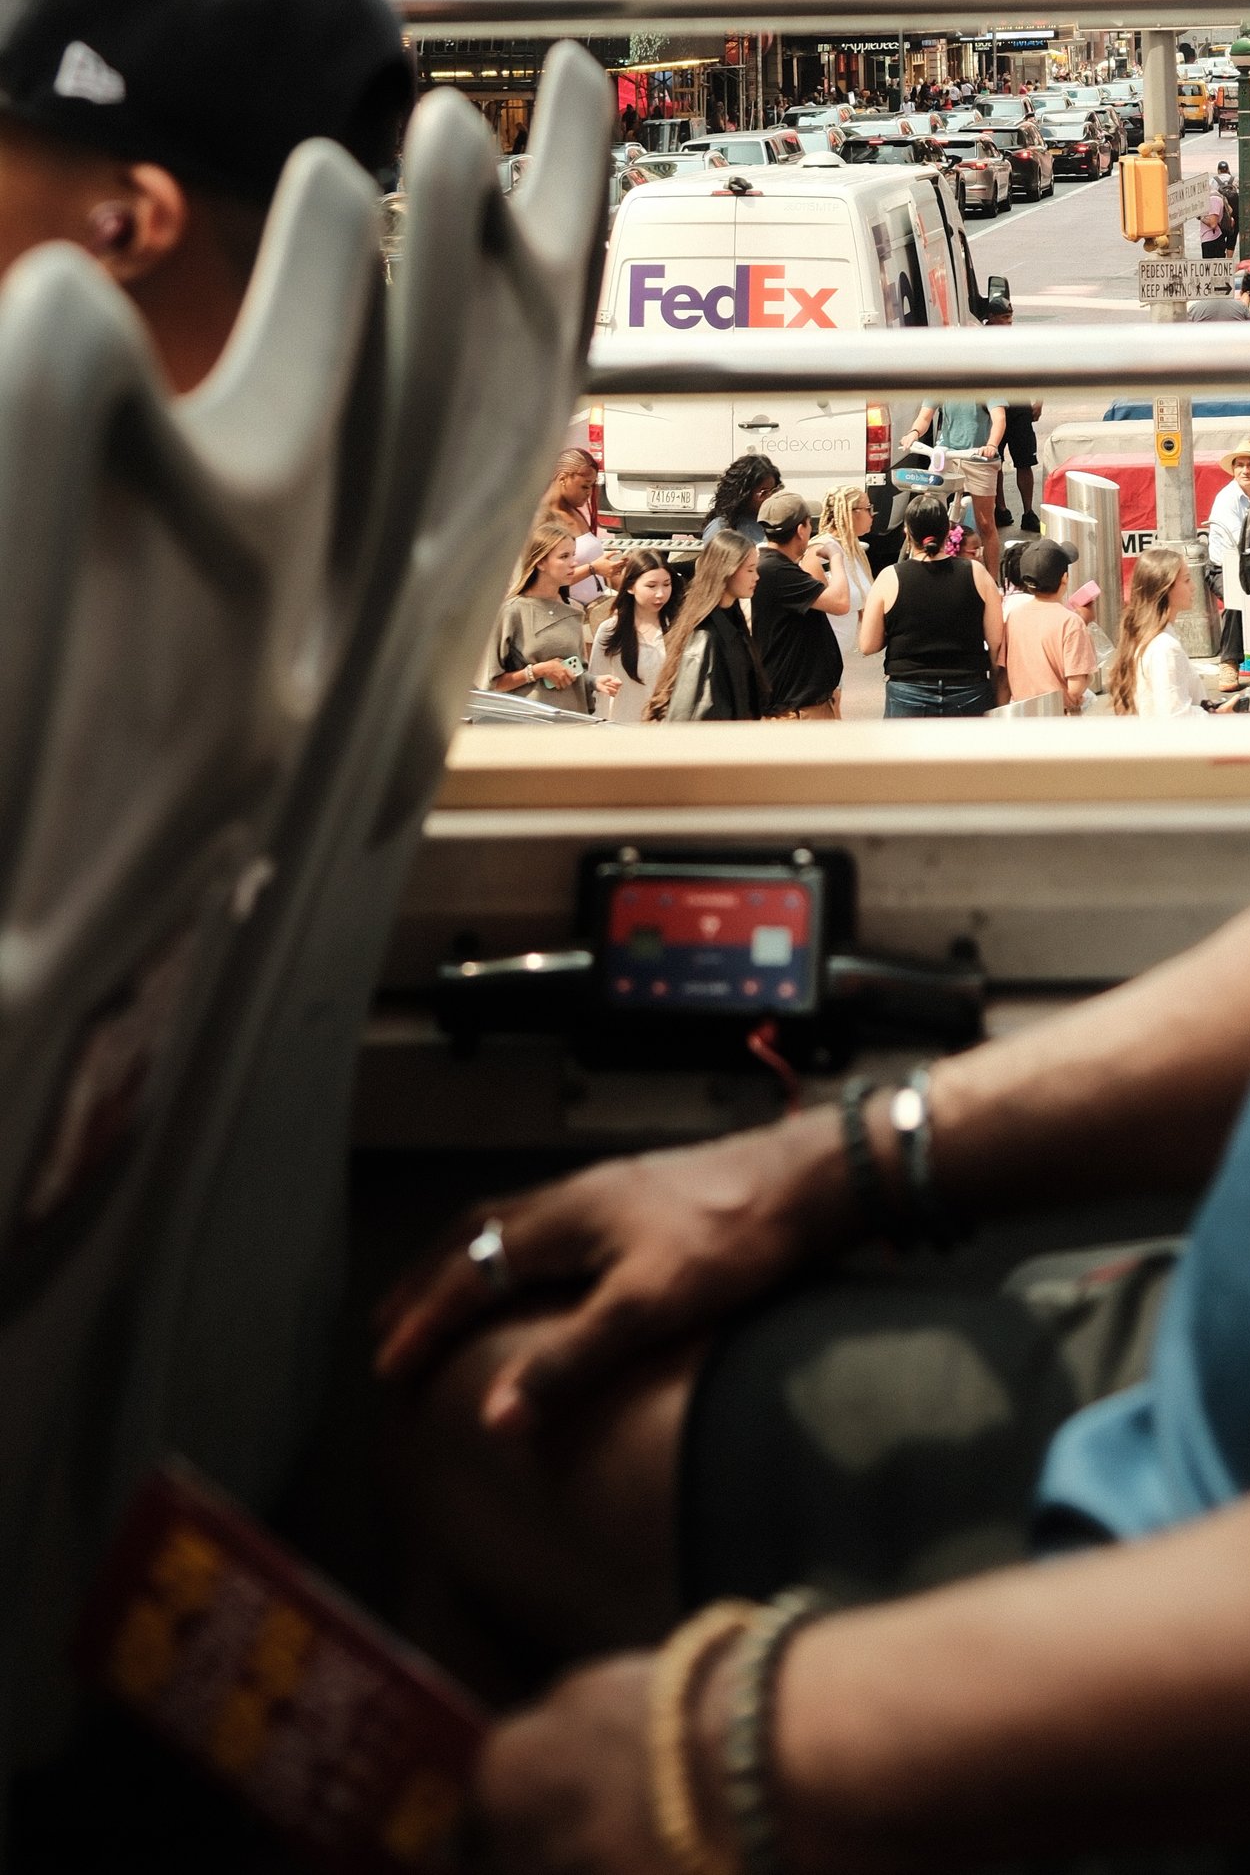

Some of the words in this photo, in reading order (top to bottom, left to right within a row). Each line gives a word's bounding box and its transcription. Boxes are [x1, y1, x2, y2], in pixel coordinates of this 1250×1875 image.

[1141, 263, 1188, 279] PEDESTRIAN
[1190, 263, 1211, 277] FLOW
[1213, 262, 1233, 276] ZONE
[628, 264, 839, 331] FedEx
[1141, 283, 1160, 298] KEEP
[760, 436, 851, 453] fedex.com
[1121, 533, 1158, 553] ME
